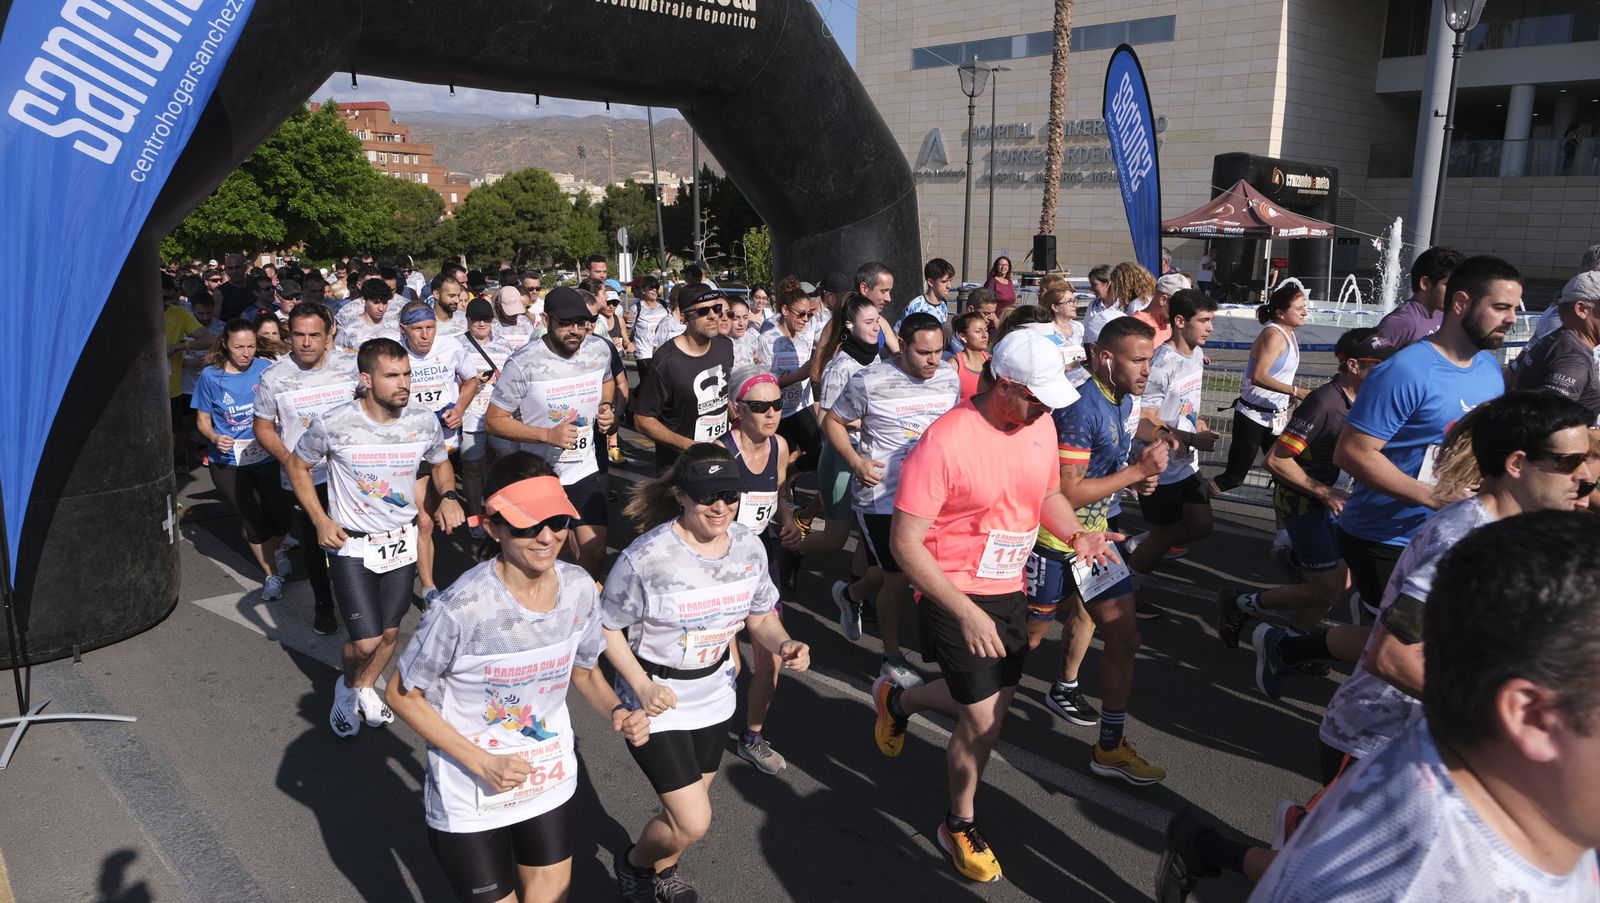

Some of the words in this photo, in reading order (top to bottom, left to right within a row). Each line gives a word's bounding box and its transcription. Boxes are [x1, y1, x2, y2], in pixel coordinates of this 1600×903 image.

[696, 5, 756, 29] deportivo
[8, 0, 202, 164] sanch
[415, 391, 442, 402] 137
[706, 421, 726, 437] 195
[755, 505, 772, 521] 51
[378, 540, 407, 560] 172
[994, 547, 1030, 563] 115
[493, 663, 538, 678] CARRERA
[539, 659, 556, 671] SIN
[518, 760, 565, 790] 64
